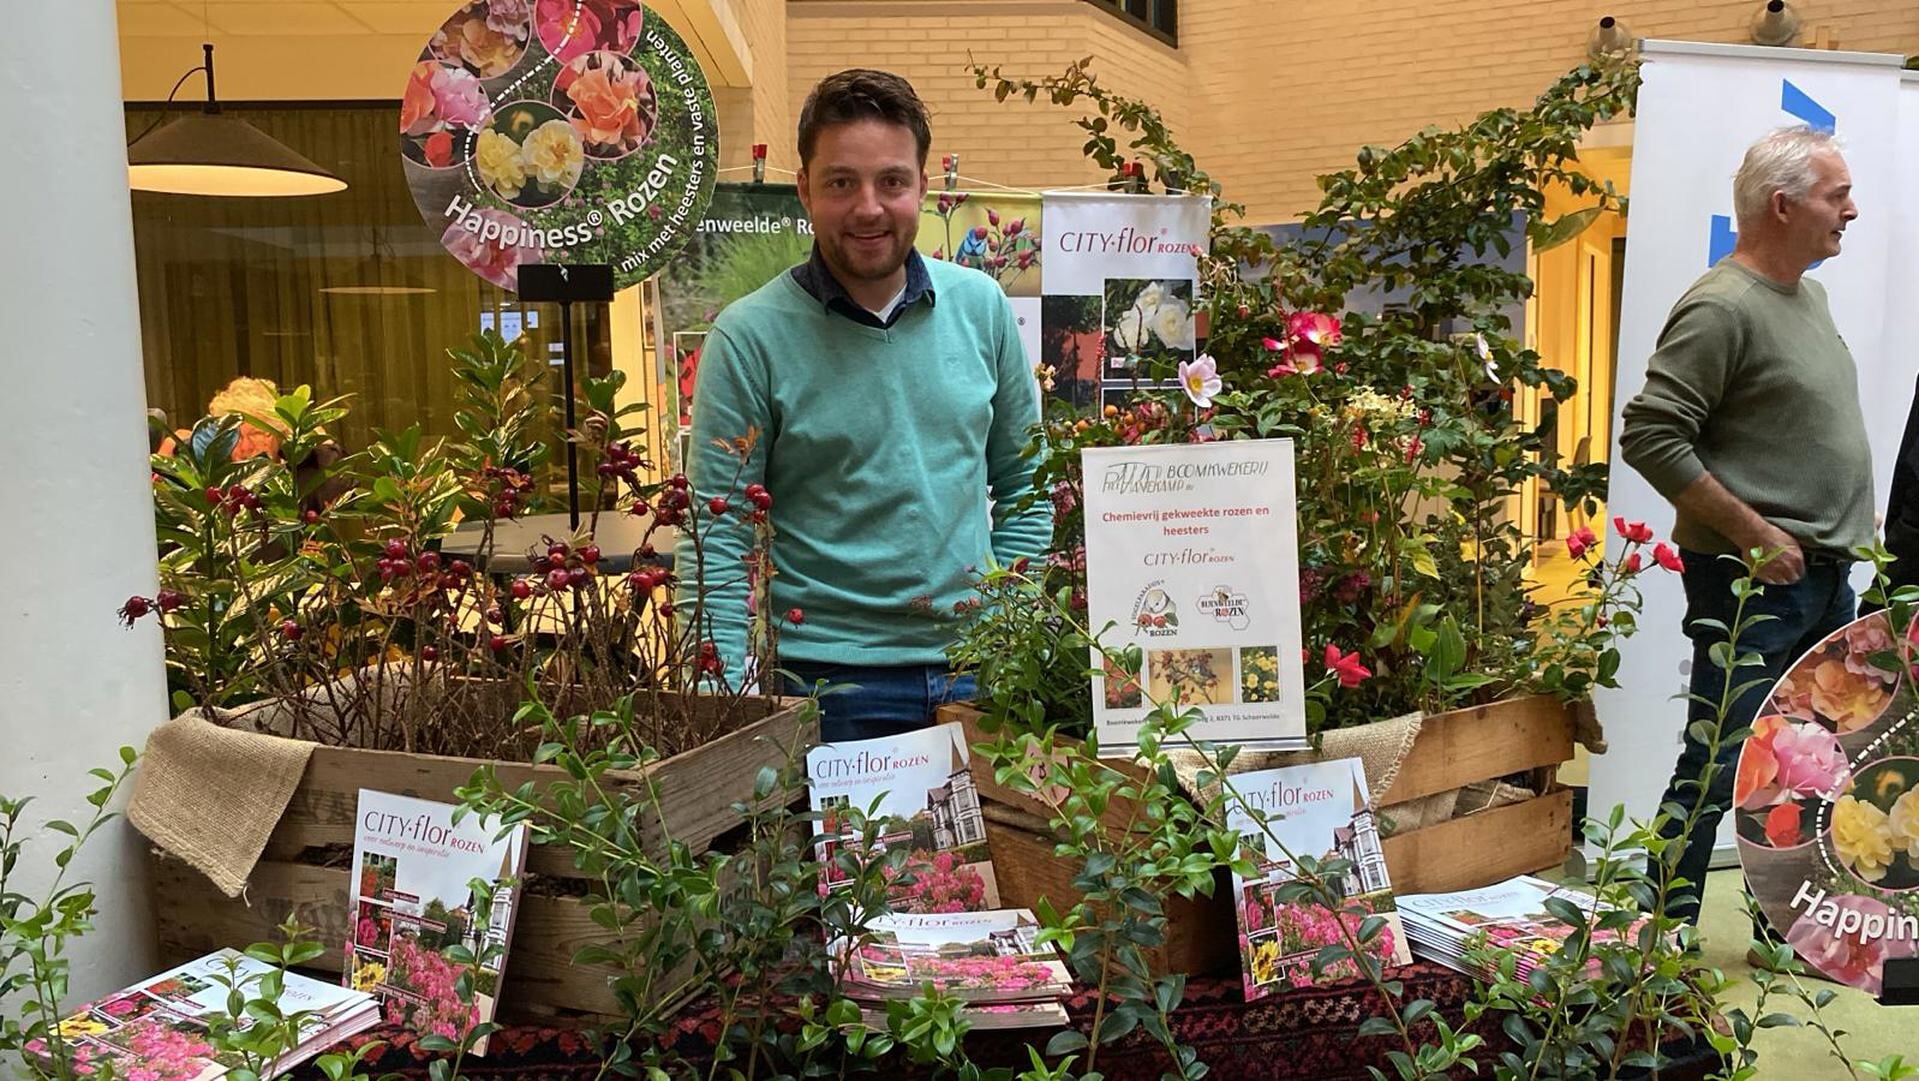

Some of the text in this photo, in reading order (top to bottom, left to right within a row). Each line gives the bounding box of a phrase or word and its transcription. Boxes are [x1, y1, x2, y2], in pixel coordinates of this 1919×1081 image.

[621, 30, 705, 273] mix met heesters en vaste planten
[444, 153, 678, 249] Happiness® Rozen
[1102, 506, 1269, 523] Chemievrij gekweekte rozen en
[1163, 526, 1209, 536] heesters
[1149, 629, 1178, 637] ROZEN
[892, 755, 929, 769] ROZEN
[1303, 789, 1334, 803] ROZEN
[450, 837, 486, 854] ROZEN
